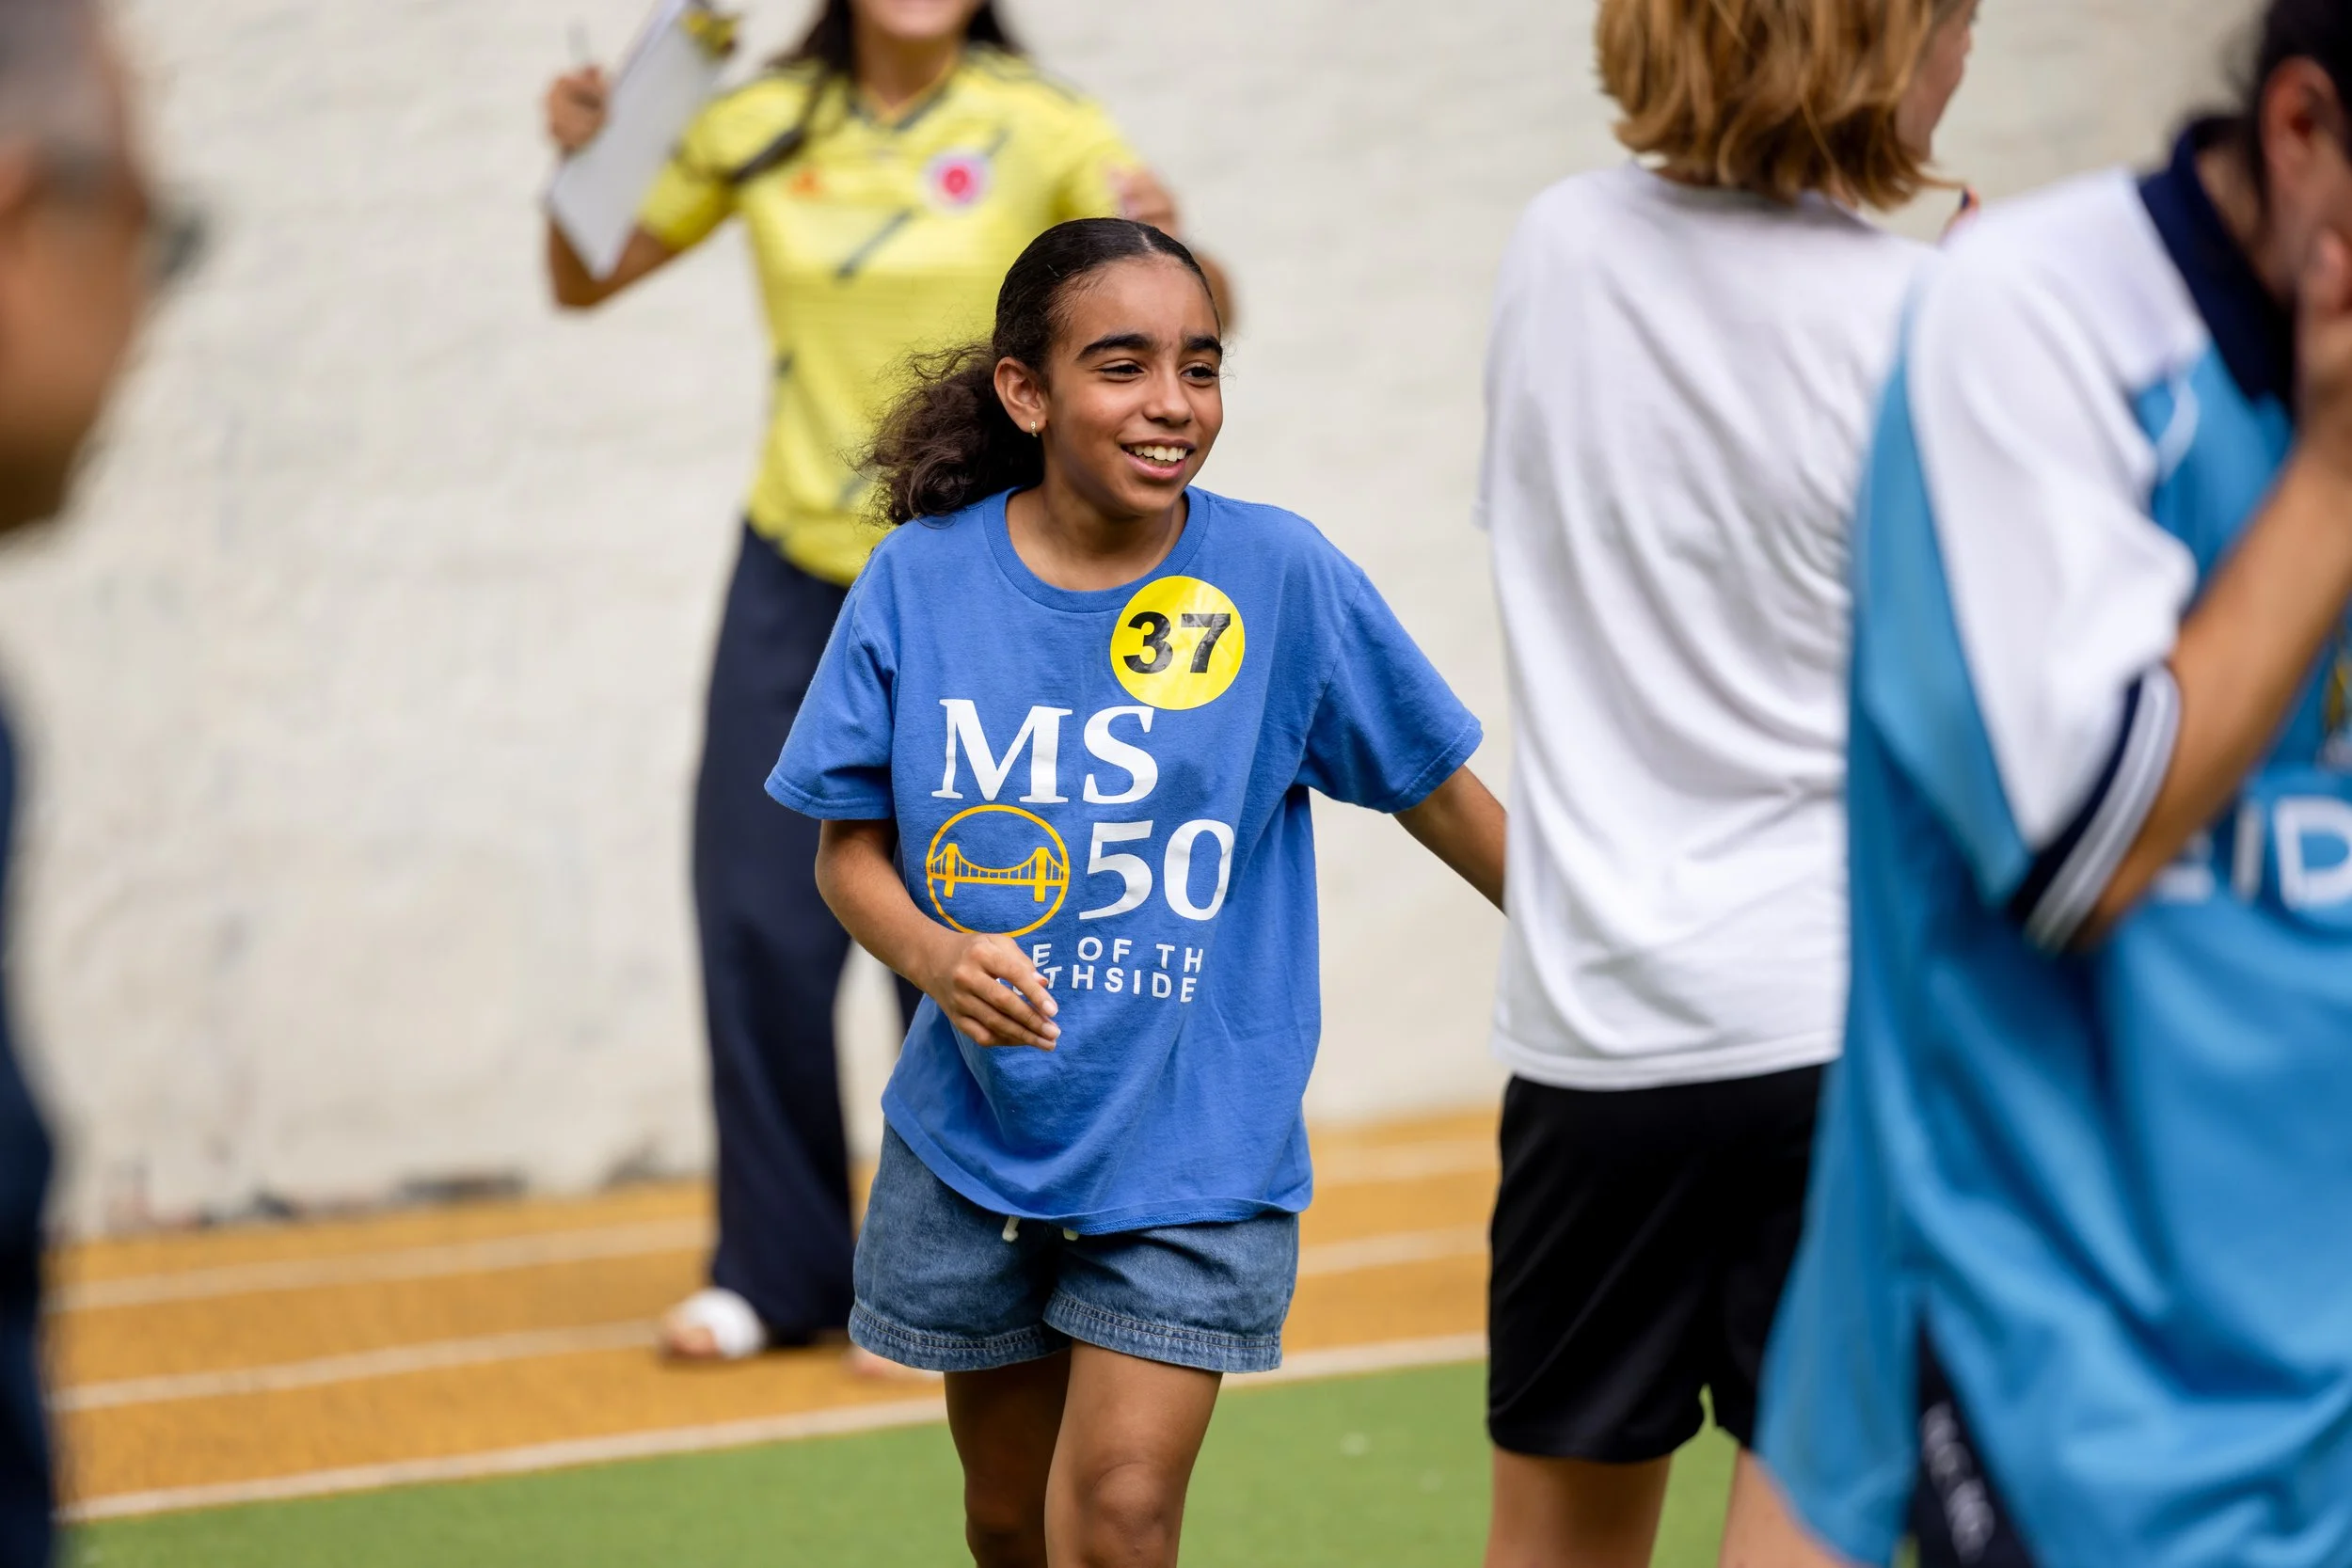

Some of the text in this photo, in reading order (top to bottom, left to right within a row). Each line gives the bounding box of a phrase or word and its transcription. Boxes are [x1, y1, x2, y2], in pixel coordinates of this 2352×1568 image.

[1123, 611, 1231, 673] 37
[931, 698, 1159, 804] MS
[1079, 819, 1235, 921] 50
[1032, 943, 1052, 967] E
[1077, 937, 1132, 963] OF
[997, 964, 1197, 1003] THSIDE
